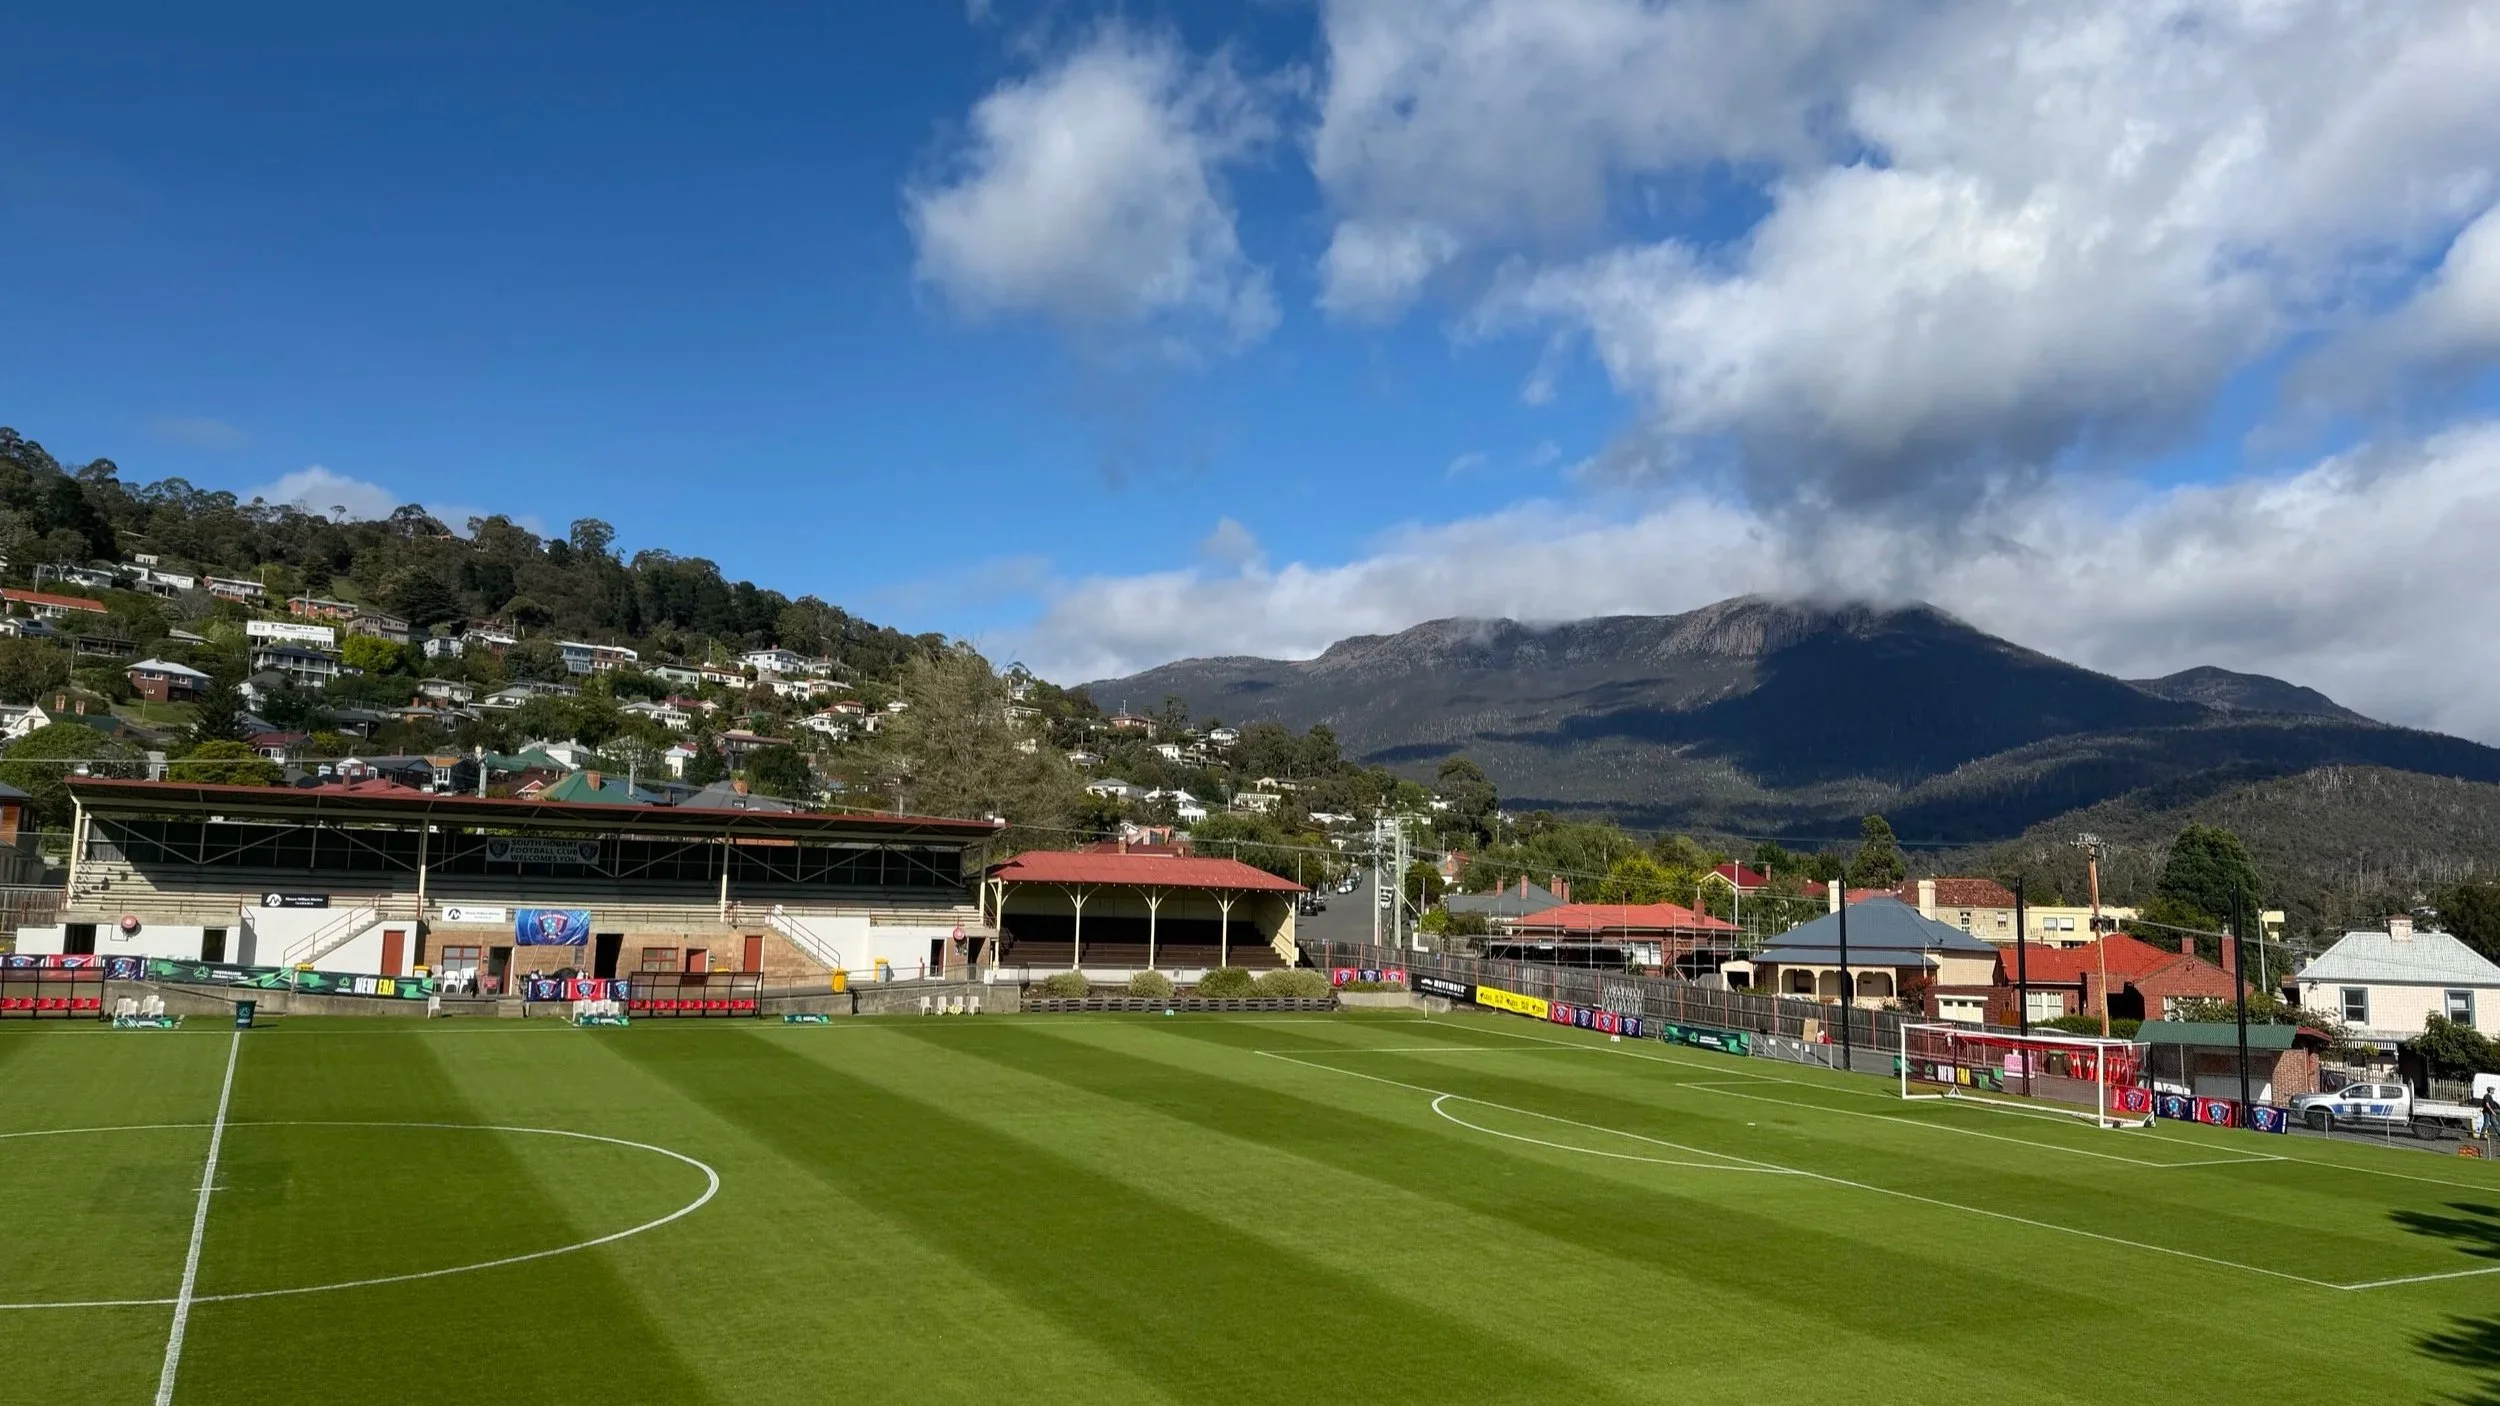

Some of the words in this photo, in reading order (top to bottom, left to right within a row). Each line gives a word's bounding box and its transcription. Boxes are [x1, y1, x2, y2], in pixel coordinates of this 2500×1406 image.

[511, 839, 542, 847] SOUTH
[543, 840, 577, 848] HOBART
[510, 847, 554, 855] FOOTBALL
[354, 977, 378, 995] NEW
[377, 978, 395, 996] ERA
[1937, 1064, 1955, 1083] NEW
[1956, 1066, 1971, 1086] ERA
